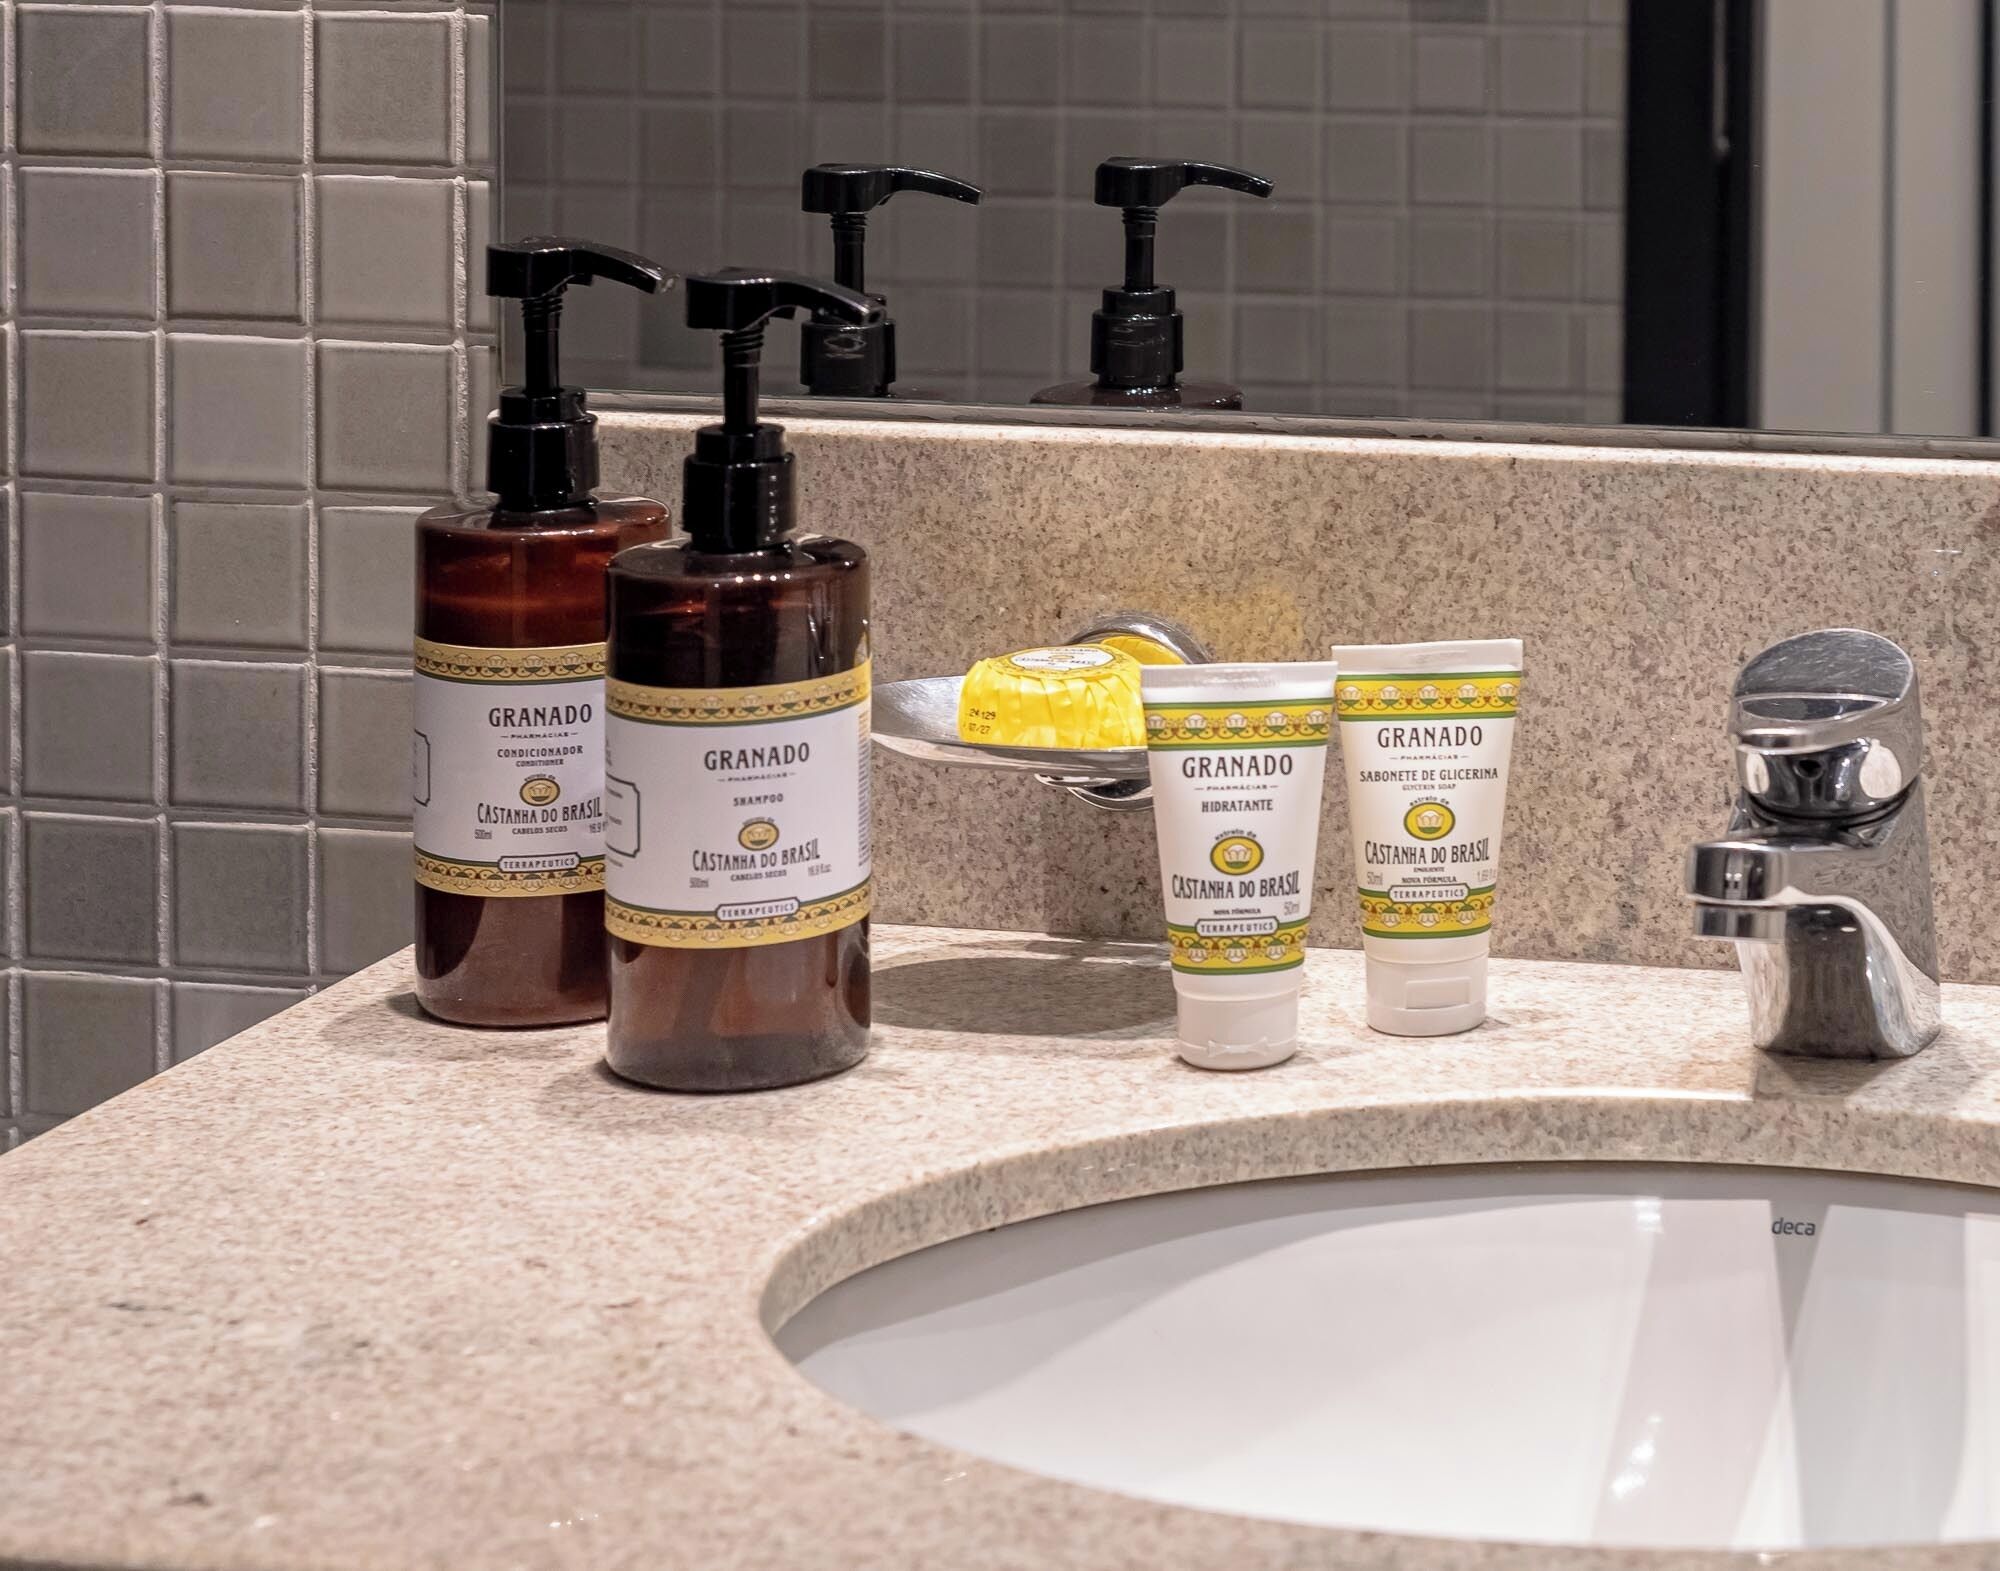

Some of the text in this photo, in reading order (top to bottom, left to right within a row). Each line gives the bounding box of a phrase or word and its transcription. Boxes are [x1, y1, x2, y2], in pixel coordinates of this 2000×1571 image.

[488, 703, 593, 727] GRANADO
[1377, 725, 1483, 749] GRANADO
[497, 745, 584, 758] CONDICIONADOR
[704, 742, 810, 771] GRANADO
[515, 758, 564, 768] CONDITIONER
[1181, 754, 1294, 779] GRANADO
[1359, 767, 1499, 783] SABONETE DE GLICERINA
[1438, 783, 1456, 791] SOAP
[733, 793, 784, 807] SHAMPOO
[1201, 799, 1273, 813] HIDRATANTE
[477, 803, 538, 825] CASTANHA
[541, 808, 558, 823] DO
[562, 797, 603, 822] BRASIL
[511, 825, 568, 835] CABELOS SECOS
[692, 838, 821, 872] CASTANHA DO BRASIL
[1364, 837, 1490, 865] CASTANHA DO BRASIL
[503, 857, 576, 869] TERRAPEUTICS
[1172, 870, 1300, 900] CASTANHA DO BRASIL
[1393, 888, 1465, 899] TERRAPEUTICS
[721, 903, 795, 918] TERRAPEUTICS
[1200, 921, 1274, 934] TERRAPEUTICS
[1771, 1217, 1816, 1236] deca
